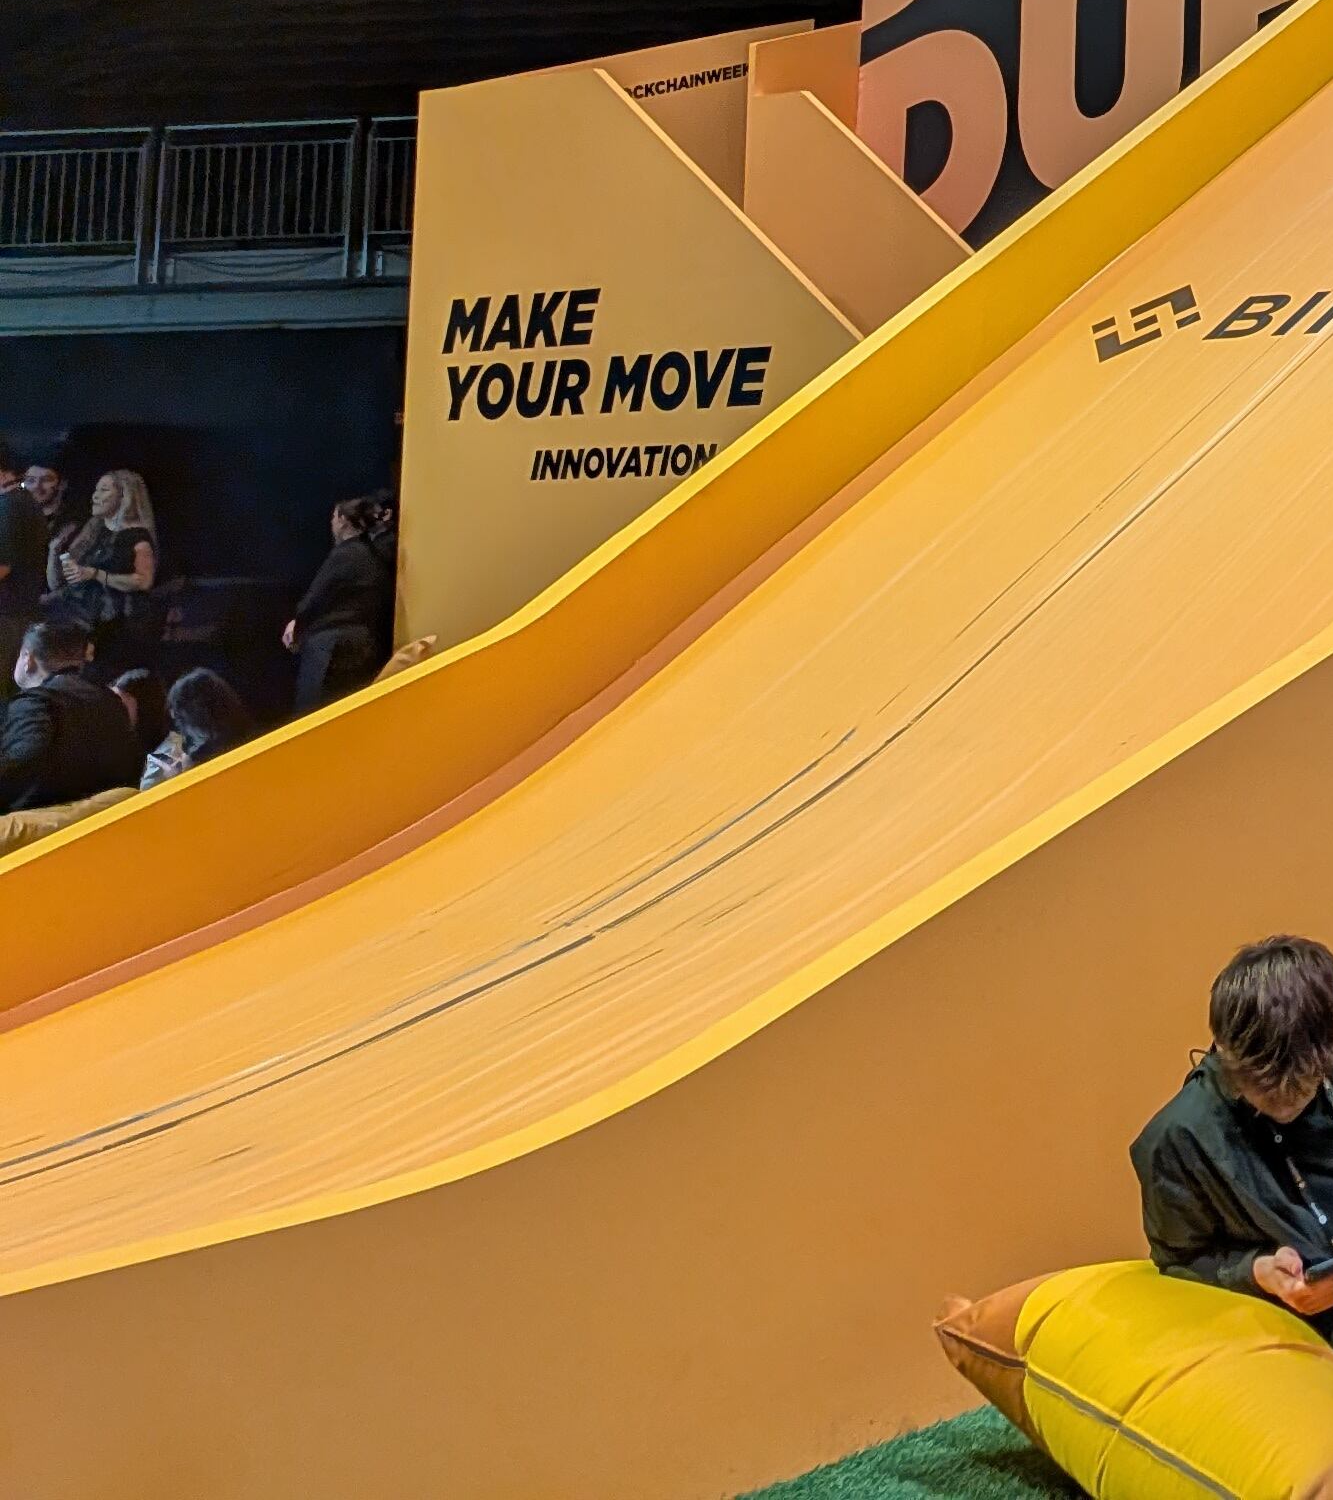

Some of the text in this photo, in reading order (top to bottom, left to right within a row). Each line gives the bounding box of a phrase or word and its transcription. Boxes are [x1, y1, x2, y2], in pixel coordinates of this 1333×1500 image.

[442, 287, 602, 354] MAKE
[446, 345, 772, 421] YOUR MOVE
[530, 443, 718, 481] INNOVATION
